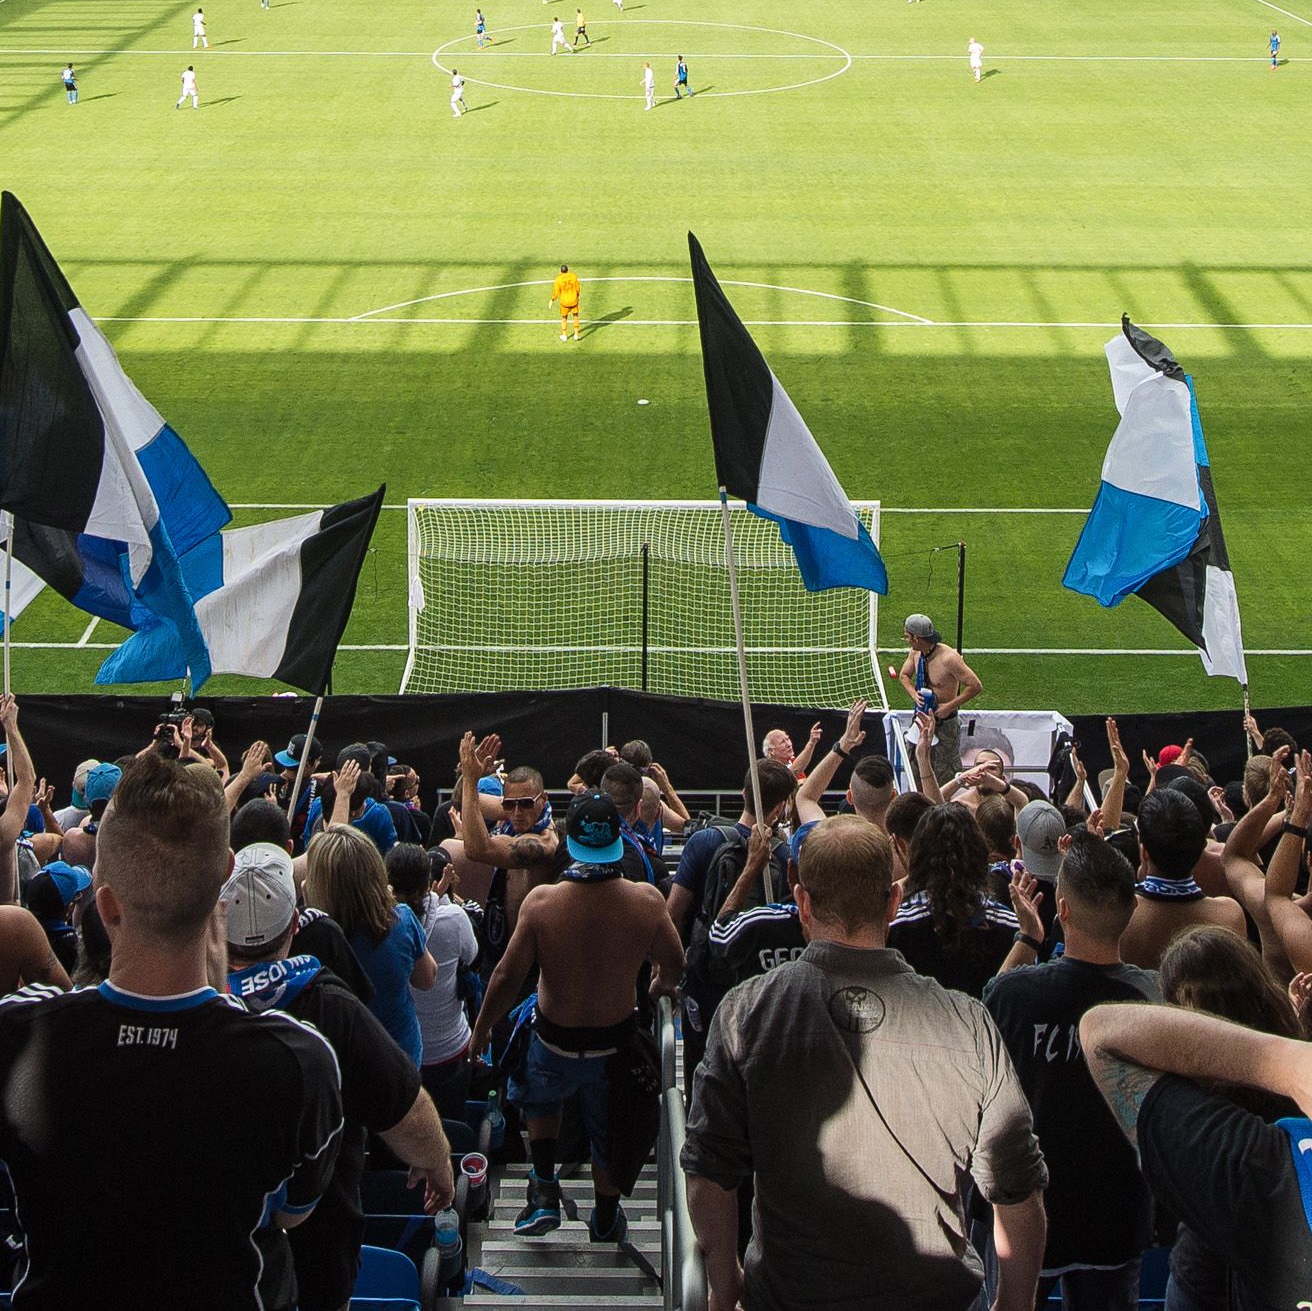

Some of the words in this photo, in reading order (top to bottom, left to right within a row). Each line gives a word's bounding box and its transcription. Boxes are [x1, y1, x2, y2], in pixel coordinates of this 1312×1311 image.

[117, 1024, 145, 1047] EST.
[146, 1028, 178, 1050] 1974
[1033, 1023, 1060, 1063] FC
